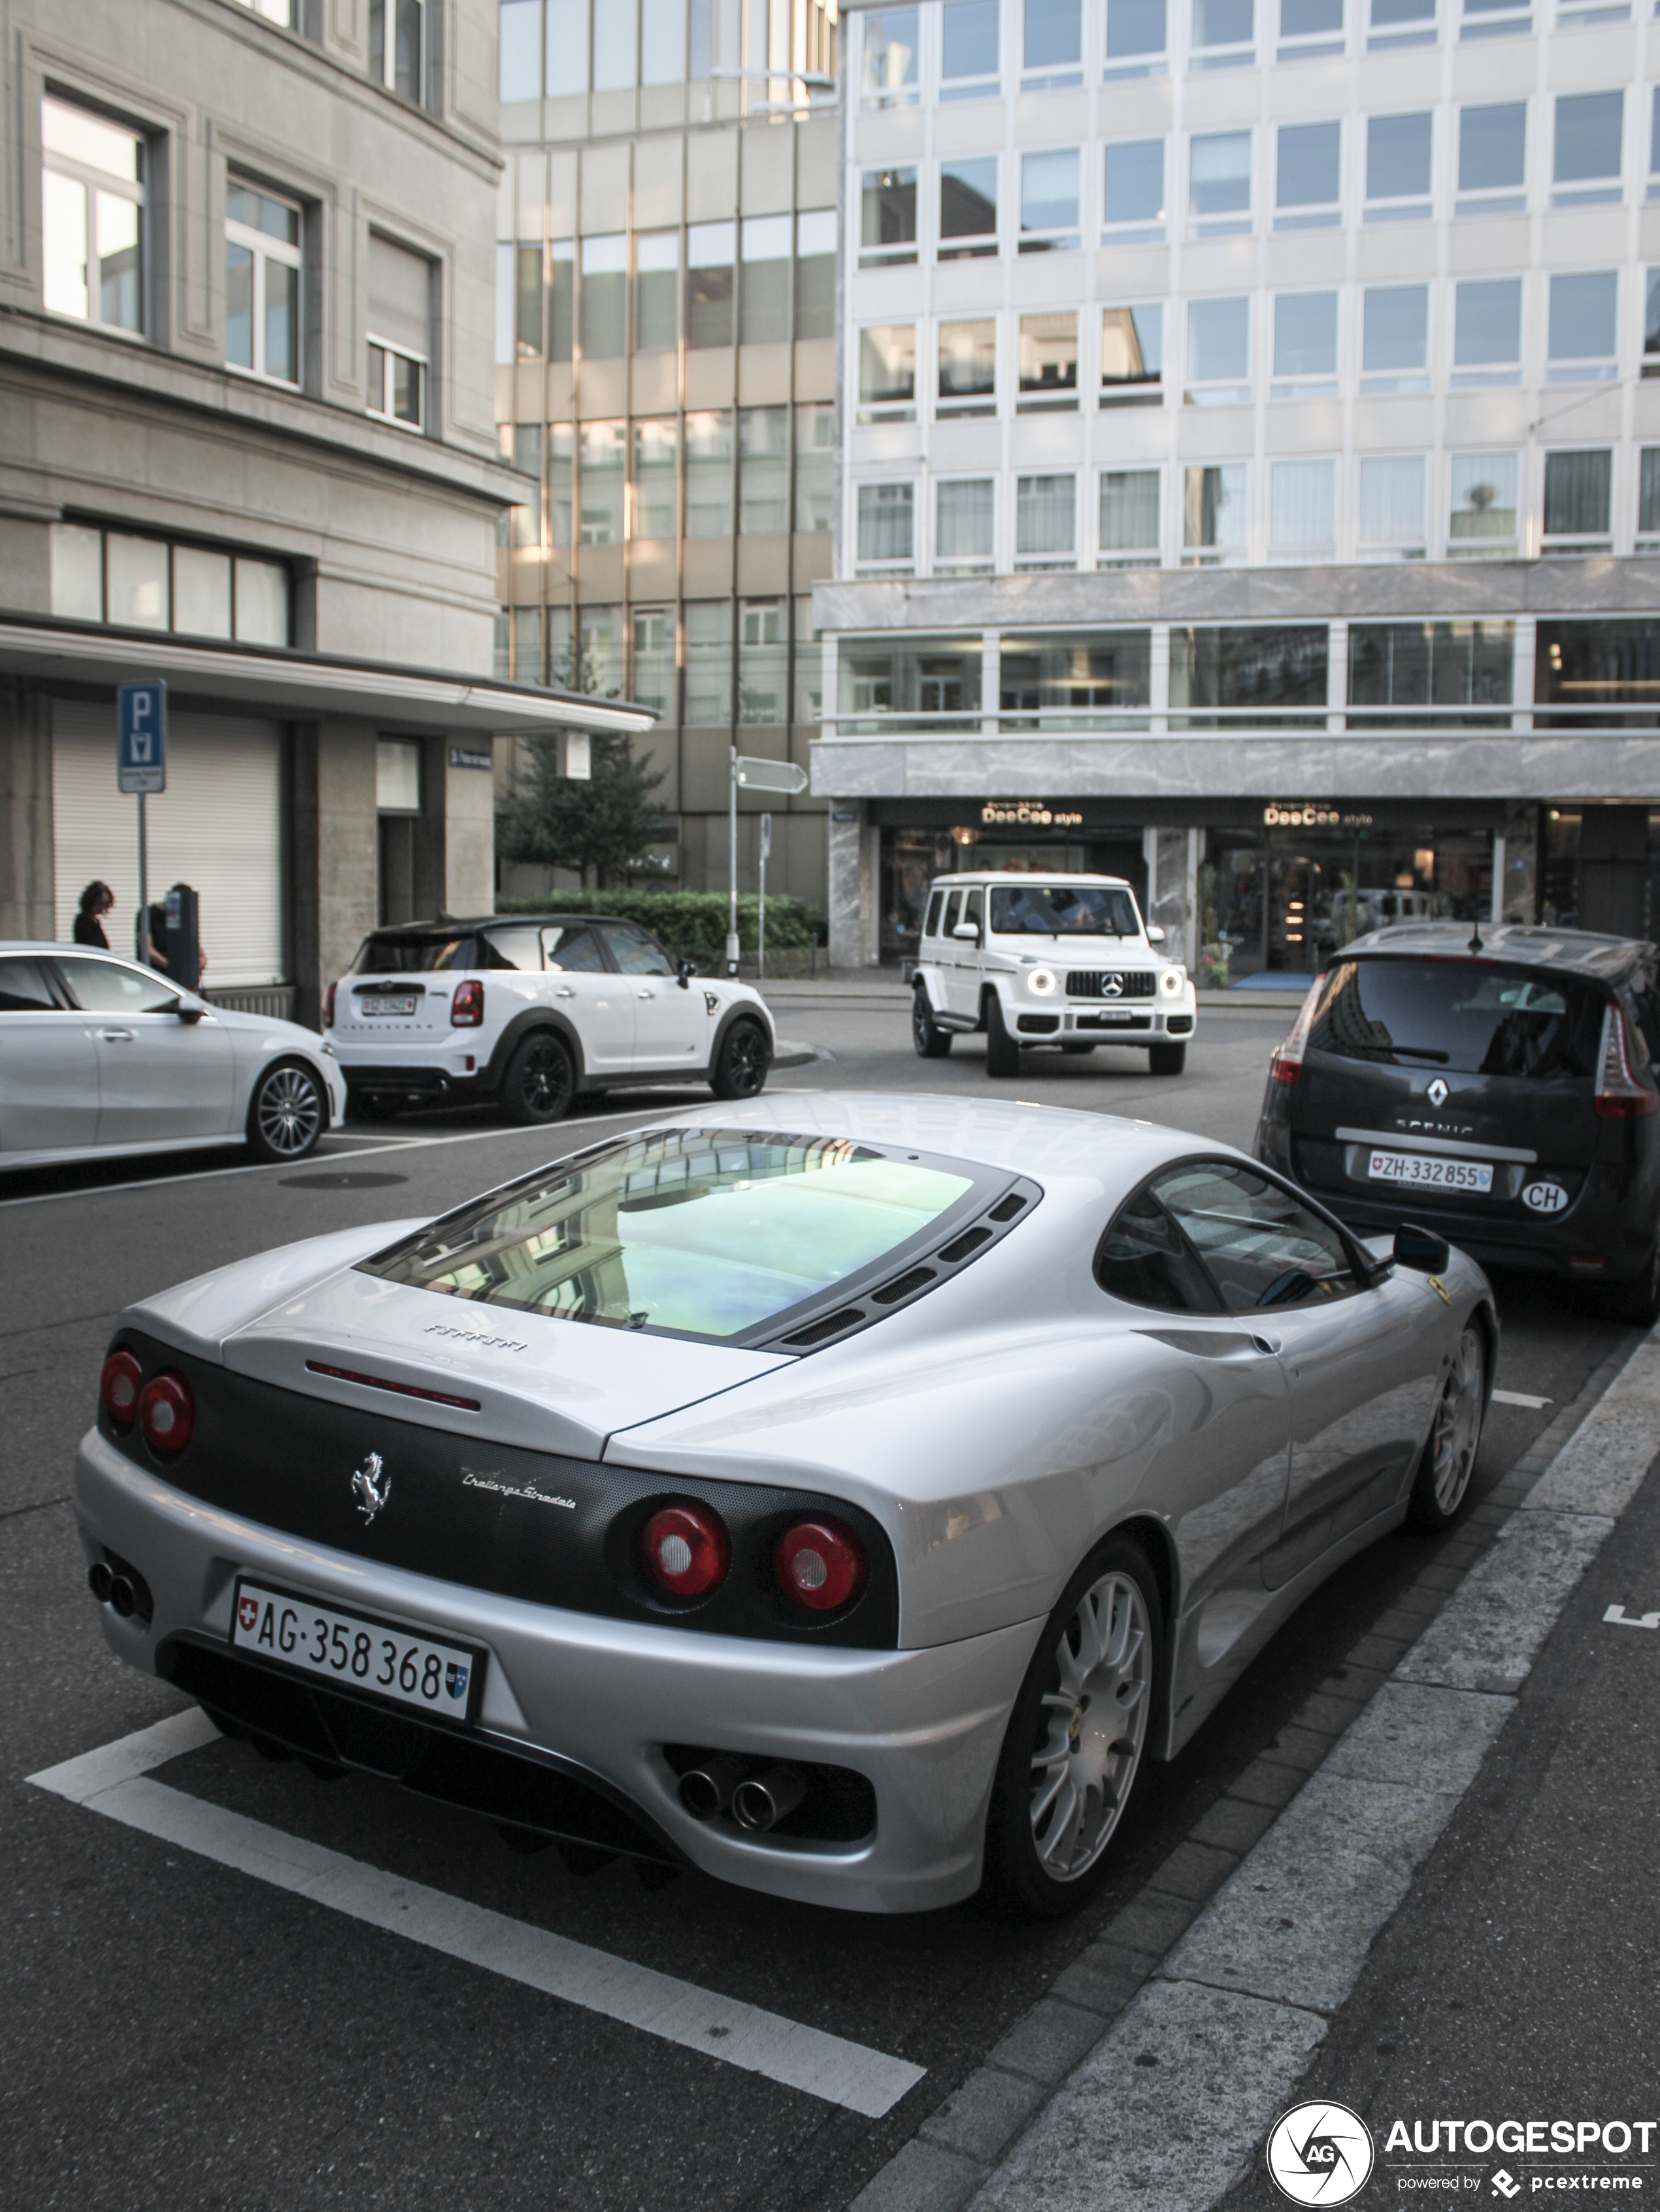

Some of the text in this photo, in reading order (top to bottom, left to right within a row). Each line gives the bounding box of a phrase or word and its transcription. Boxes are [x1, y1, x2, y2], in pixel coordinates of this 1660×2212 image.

[133, 691, 151, 731] P
[982, 806, 1082, 827] DeeCee style
[1264, 807, 1372, 828] DeeCee style
[1529, 1185, 1559, 1209] CH
